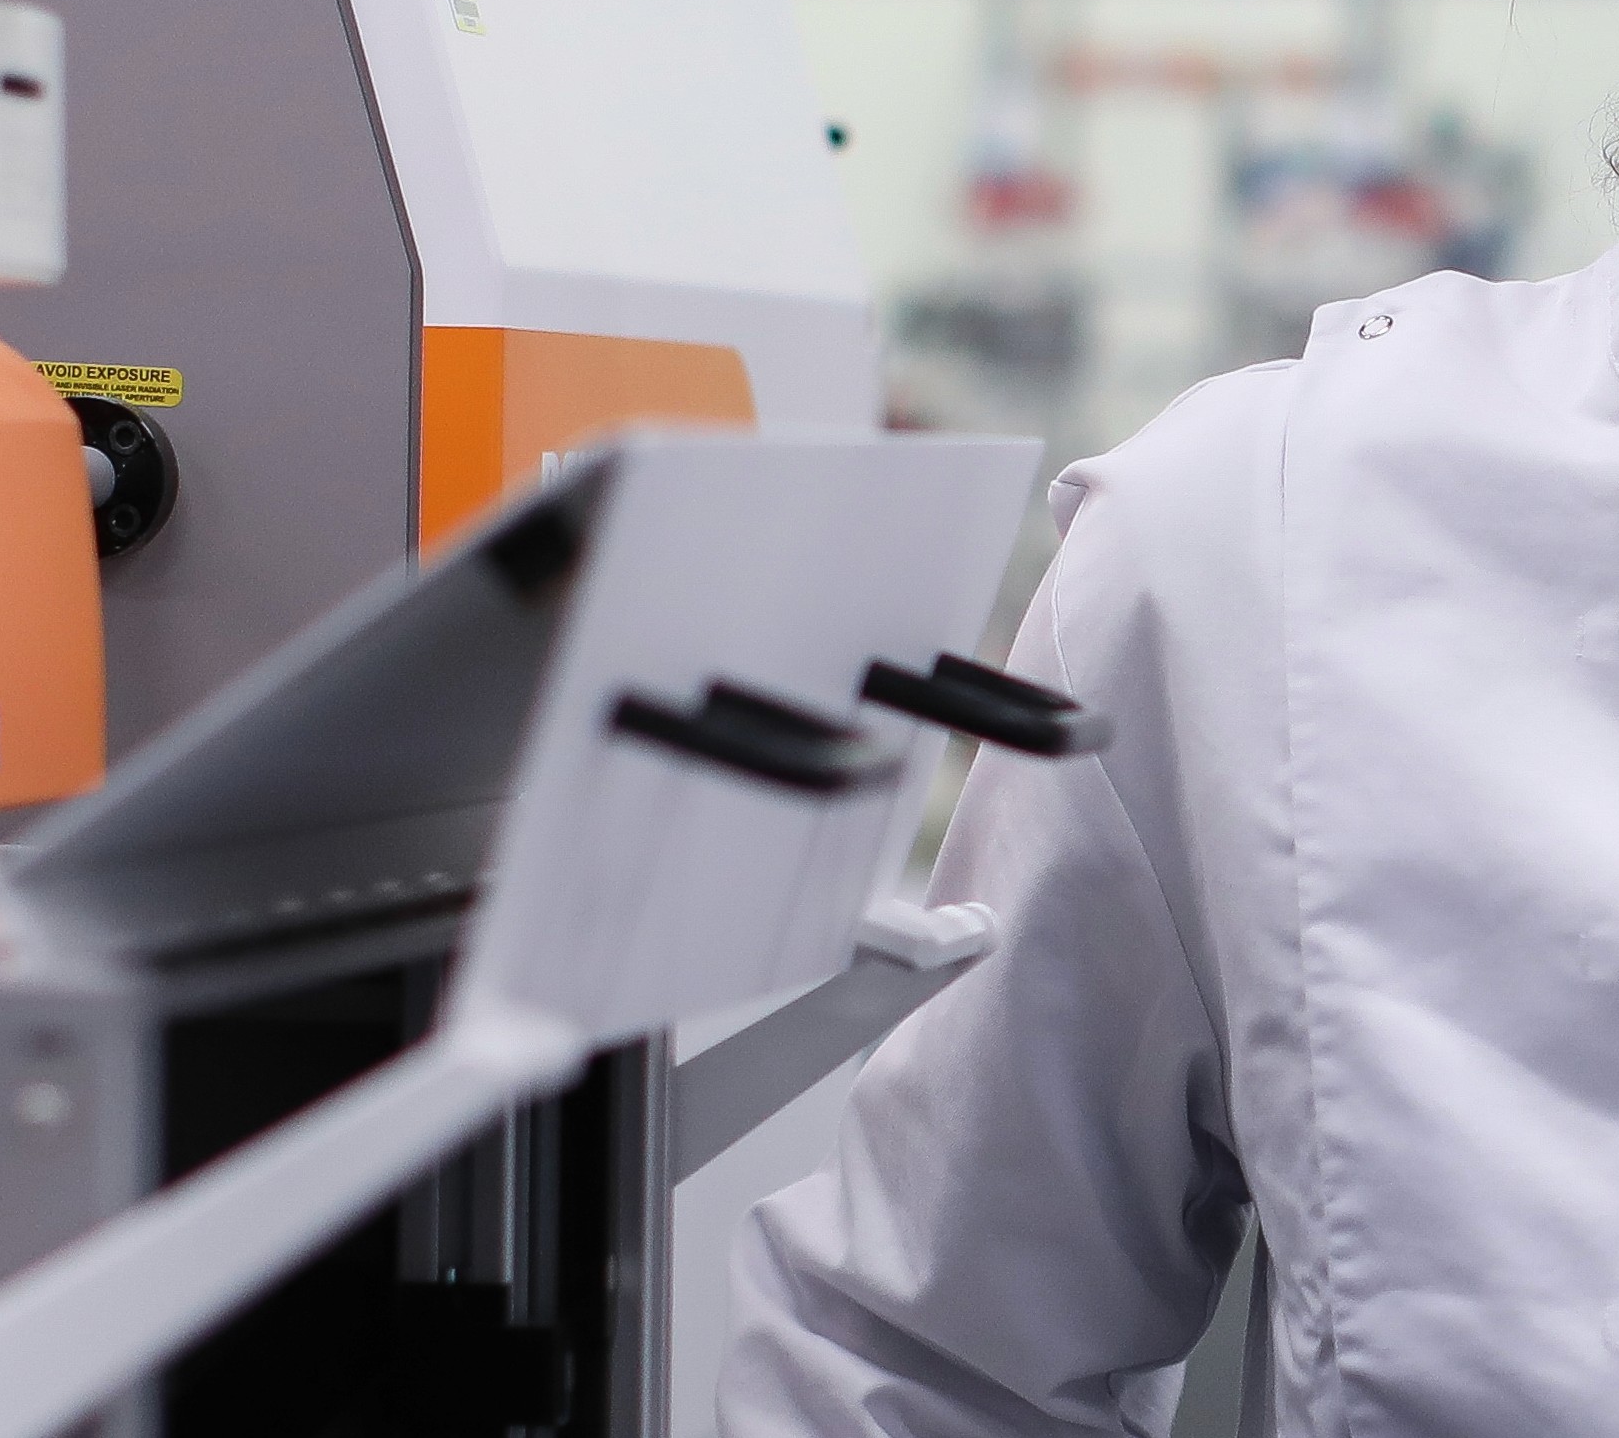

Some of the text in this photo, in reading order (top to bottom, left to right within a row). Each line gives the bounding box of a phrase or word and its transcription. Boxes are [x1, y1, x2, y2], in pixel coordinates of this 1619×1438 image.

[35, 364, 171, 383] AVOID EXPOSURE
[55, 381, 180, 395] AND INVISIBLE LASER RADIATION
[125, 394, 165, 403] APERTURE
